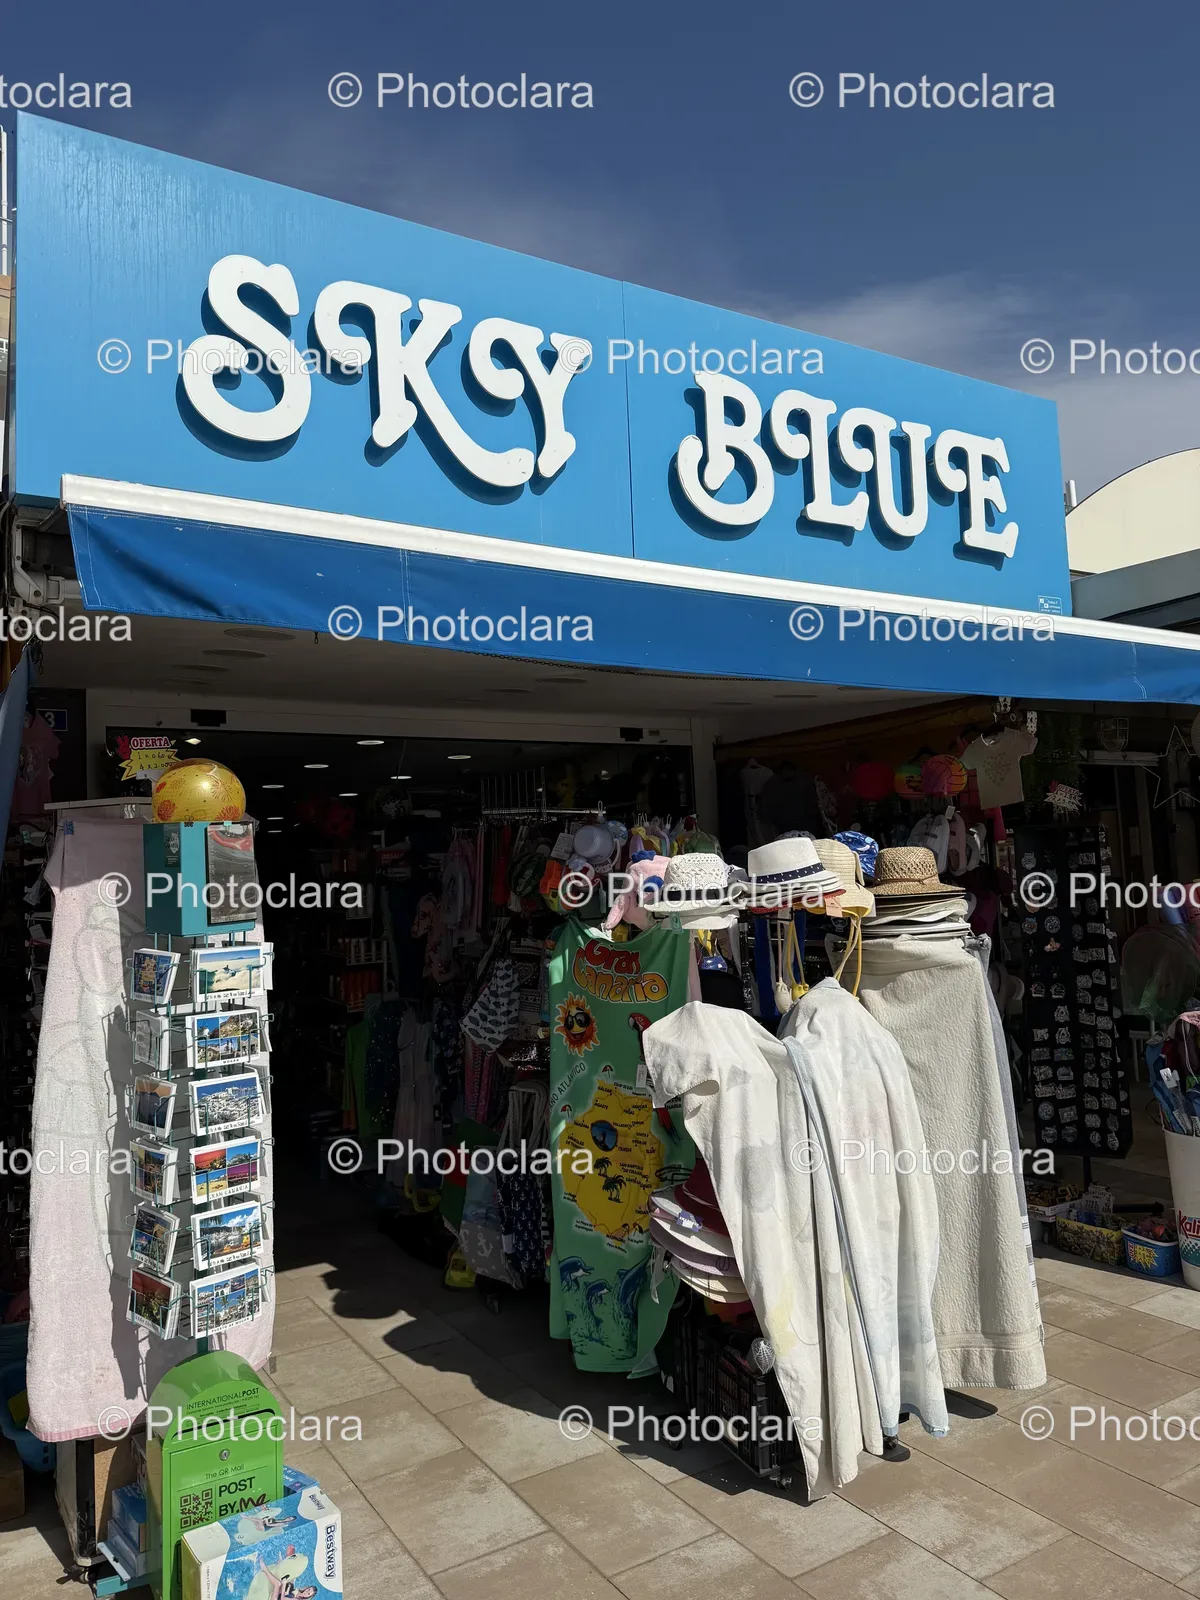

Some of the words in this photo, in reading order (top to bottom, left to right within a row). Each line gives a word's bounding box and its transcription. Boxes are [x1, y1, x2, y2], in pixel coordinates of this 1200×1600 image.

[182, 254, 593, 488] SKY
[676, 370, 1019, 559] BLUE
[131, 737, 171, 749] OFERTA
[585, 939, 641, 975] Gran
[573, 947, 669, 1002] Canaria
[186, 1387, 260, 1410] INTERNATIONALPOST
[218, 1468, 229, 1476] QR
[218, 1476, 256, 1498] POST
[325, 1524, 337, 1580] Bestway
